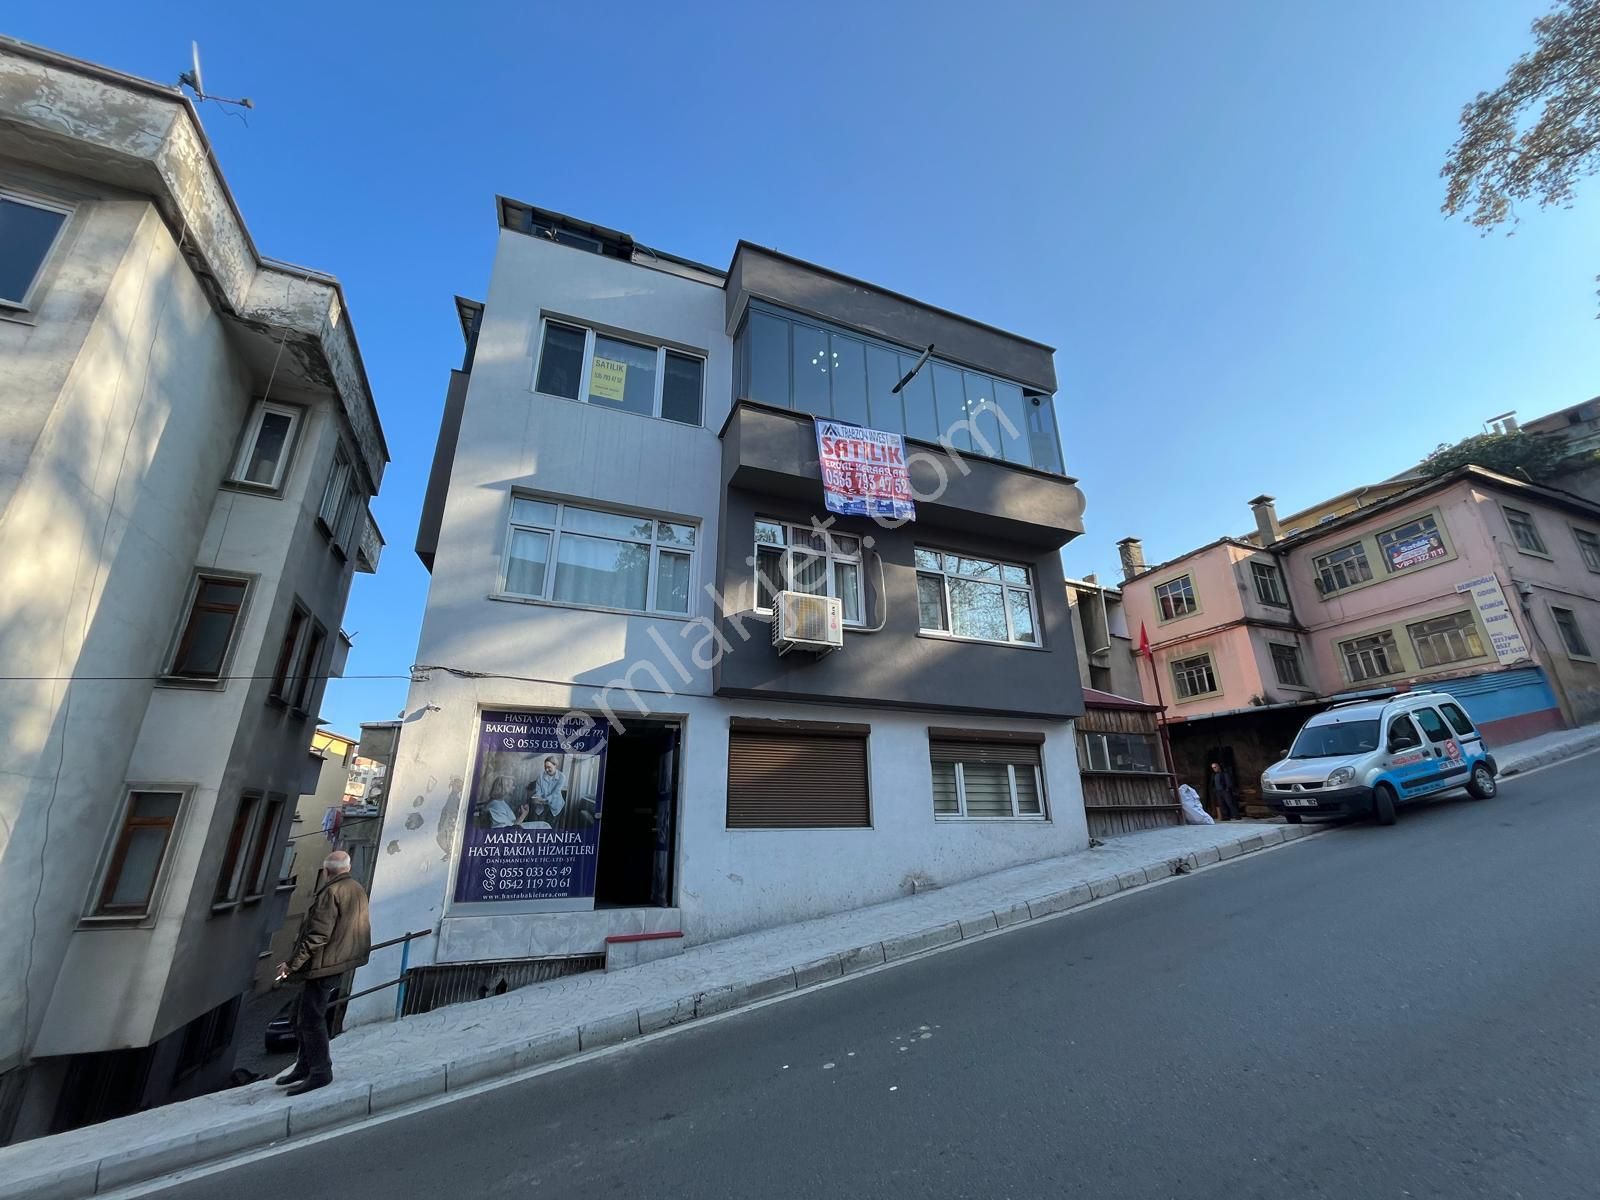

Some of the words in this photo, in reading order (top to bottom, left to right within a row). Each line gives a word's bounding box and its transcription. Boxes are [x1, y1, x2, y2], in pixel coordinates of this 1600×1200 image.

[596, 360, 624, 372] SATILIK
[822, 437, 903, 464] SATILIK
[880, 477, 892, 492] 47
[505, 714, 533, 722] HASTA
[486, 724, 527, 734] BAKICIMI
[529, 727, 590, 737] ARIYORSUNUZ
[517, 739, 539, 748] 0555
[542, 740, 559, 749] 033
[561, 741, 572, 749] 65
[574, 741, 585, 750] 49
[484, 831, 533, 844] MARİYA
[536, 831, 582, 843] HANİFA
[468, 846, 501, 857] HASTA
[503, 846, 535, 856] BAKIM
[537, 844, 595, 856] HİZMETLERİ
[500, 868, 524, 878] 0555
[526, 867, 544, 877] 033
[545, 867, 558, 876] 65
[560, 866, 572, 876] 49
[499, 879, 524, 890] 0542
[526, 879, 544, 889] 119
[546, 878, 558, 888] 70
[560, 878, 570, 888] 61
